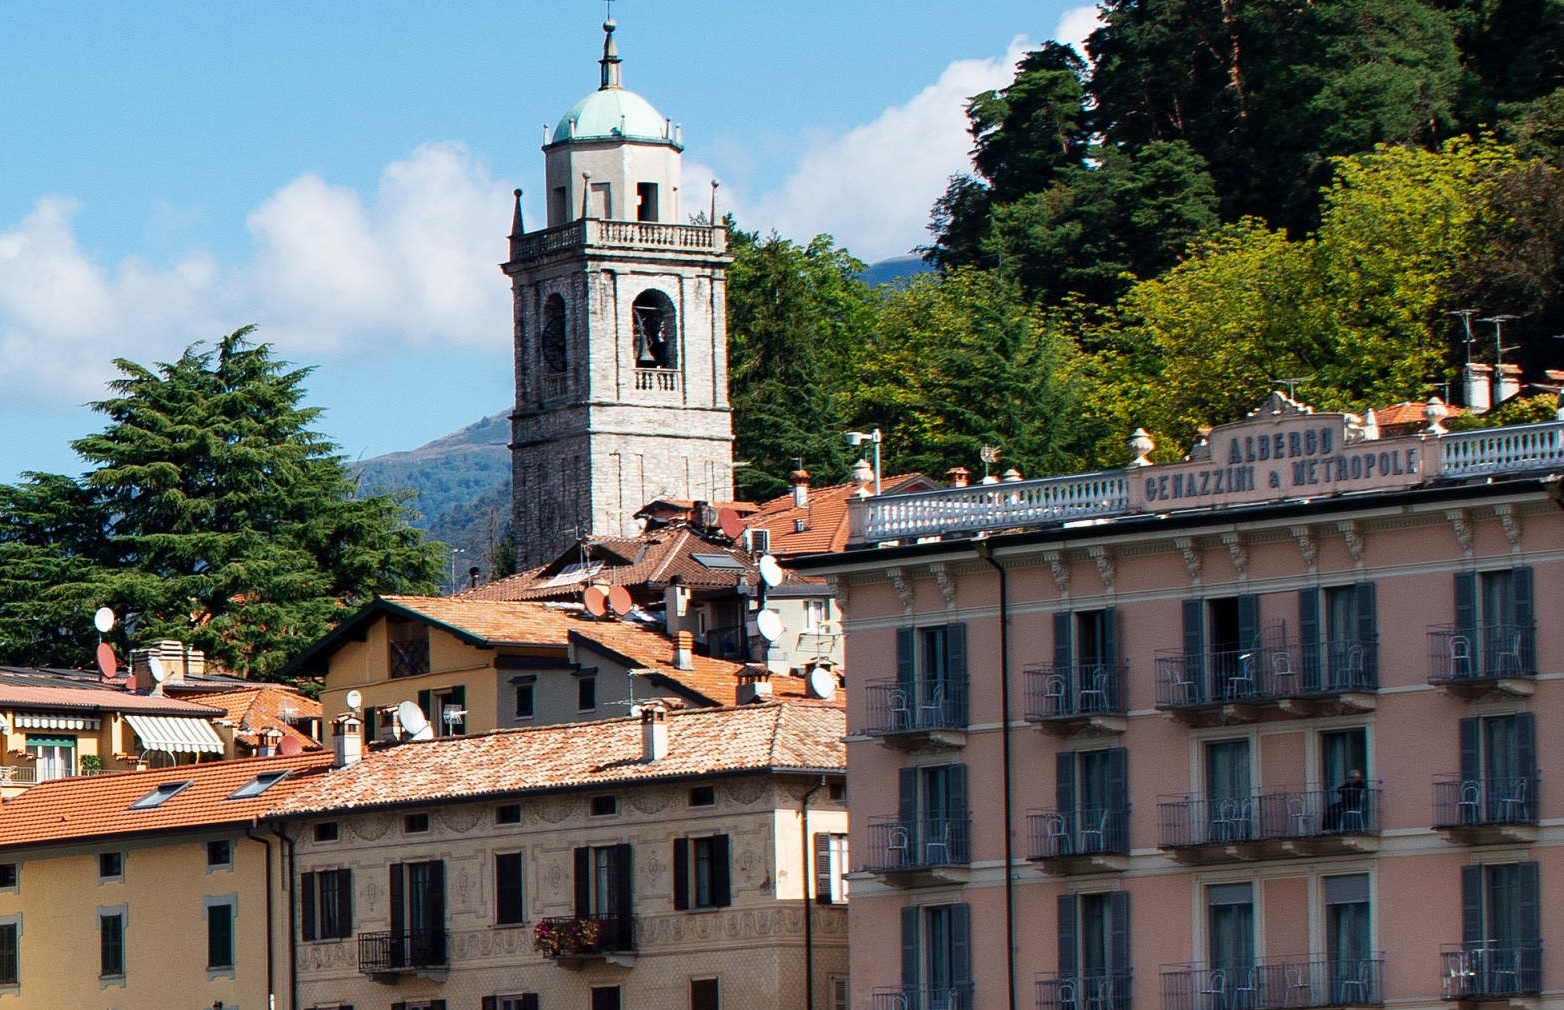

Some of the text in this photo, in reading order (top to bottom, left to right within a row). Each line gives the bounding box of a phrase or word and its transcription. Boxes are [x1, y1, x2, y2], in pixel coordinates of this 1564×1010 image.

[1228, 427, 1333, 464] ALBERGO
[1144, 466, 1255, 501] GENAZZINI
[1291, 448, 1417, 487] METROPOLE
